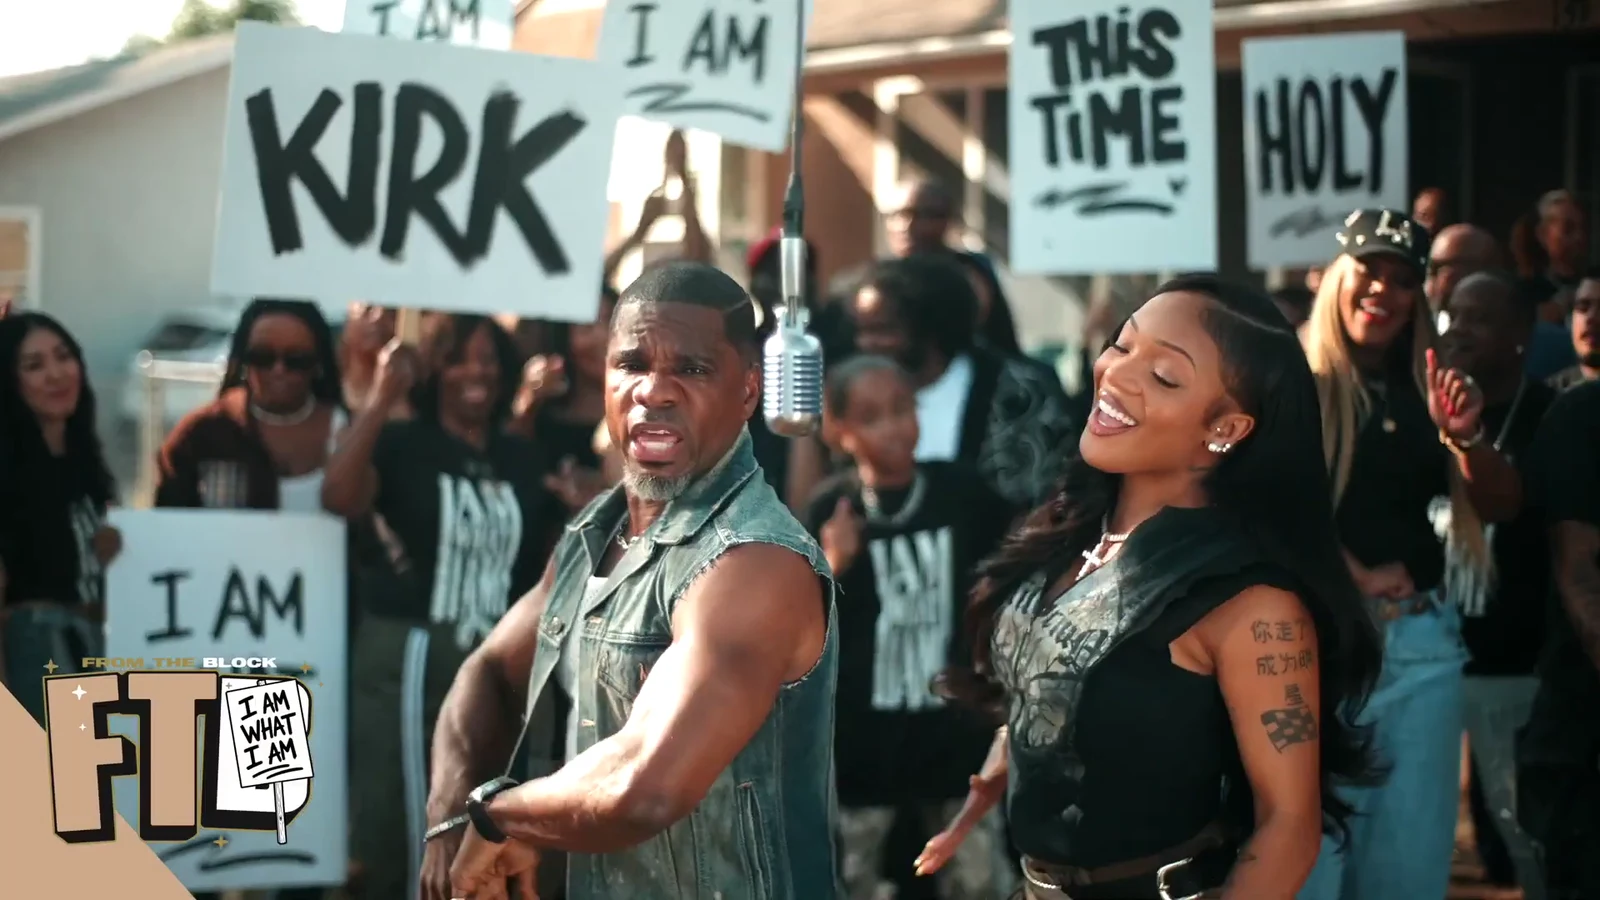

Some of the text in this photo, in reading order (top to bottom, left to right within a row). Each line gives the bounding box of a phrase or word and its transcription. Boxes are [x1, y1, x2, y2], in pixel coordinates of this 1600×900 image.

[624, 2, 771, 85] I AM
[245, 80, 588, 275] KIRK
[1255, 68, 1398, 196] HOLY
[145, 565, 305, 644] I AM
